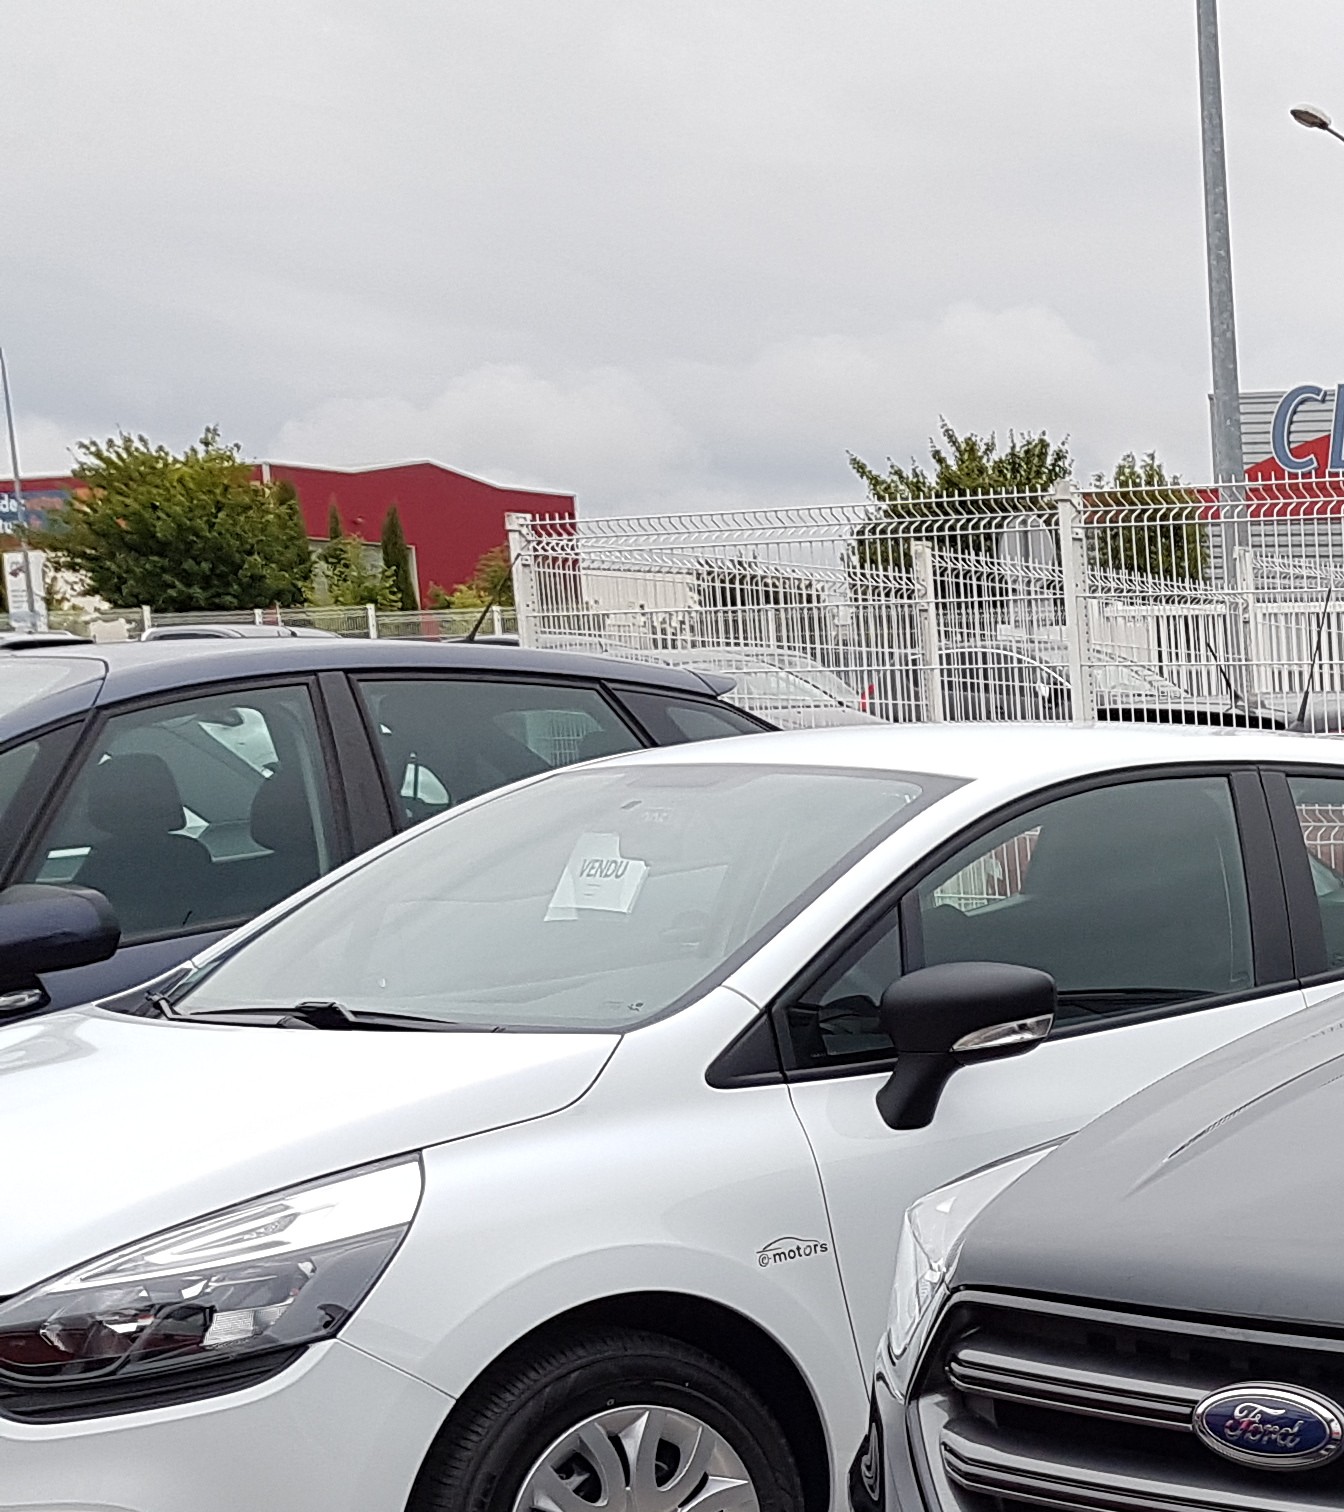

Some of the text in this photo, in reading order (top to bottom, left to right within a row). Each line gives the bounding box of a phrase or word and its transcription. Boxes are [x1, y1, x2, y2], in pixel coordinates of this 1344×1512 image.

[579, 859, 629, 879] VENDU
[758, 1242, 828, 1267] e-motors
[1224, 1402, 1305, 1448] Ford
